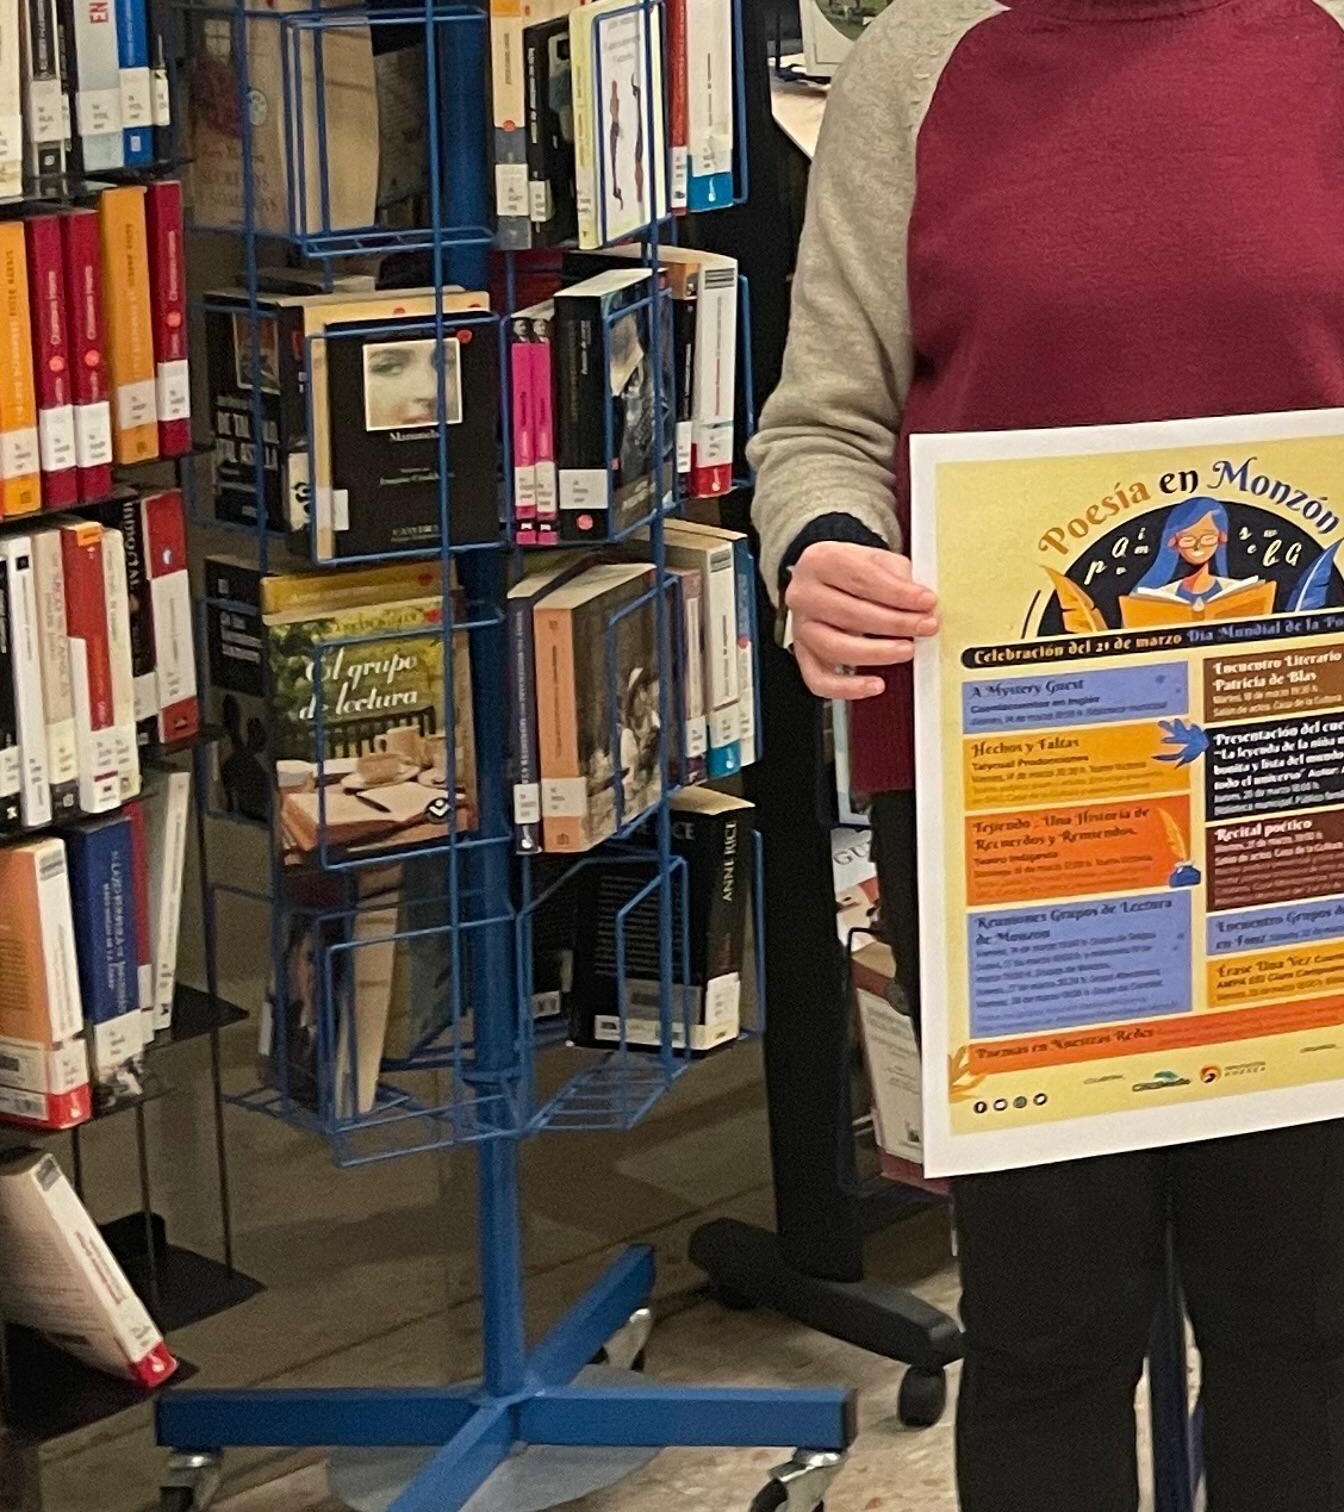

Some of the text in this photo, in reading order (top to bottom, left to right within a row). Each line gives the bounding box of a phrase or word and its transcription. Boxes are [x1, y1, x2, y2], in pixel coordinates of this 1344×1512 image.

[90, 1, 108, 24] EN
[1038, 457, 1343, 557] Poesía en Monzón
[974, 643, 1063, 665] Celebración
[1066, 639, 1091, 655] del
[1112, 635, 1132, 651] de
[1135, 632, 1181, 648] marzo
[1284, 618, 1301, 634] de
[347, 653, 418, 689] grupo
[1213, 656, 1281, 675] Encuentro
[1284, 650, 1341, 668] Literario
[970, 687, 981, 699] A
[985, 679, 1040, 699] Mystery
[1213, 668, 1316, 692] Patricia de Blas
[336, 683, 418, 715] lectura
[1213, 724, 1297, 746] Presentación
[1300, 721, 1319, 735] del
[1026, 742, 1033, 754] y
[1214, 817, 1312, 843] Recital poético
[723, 821, 737, 902] ANNE RICE
